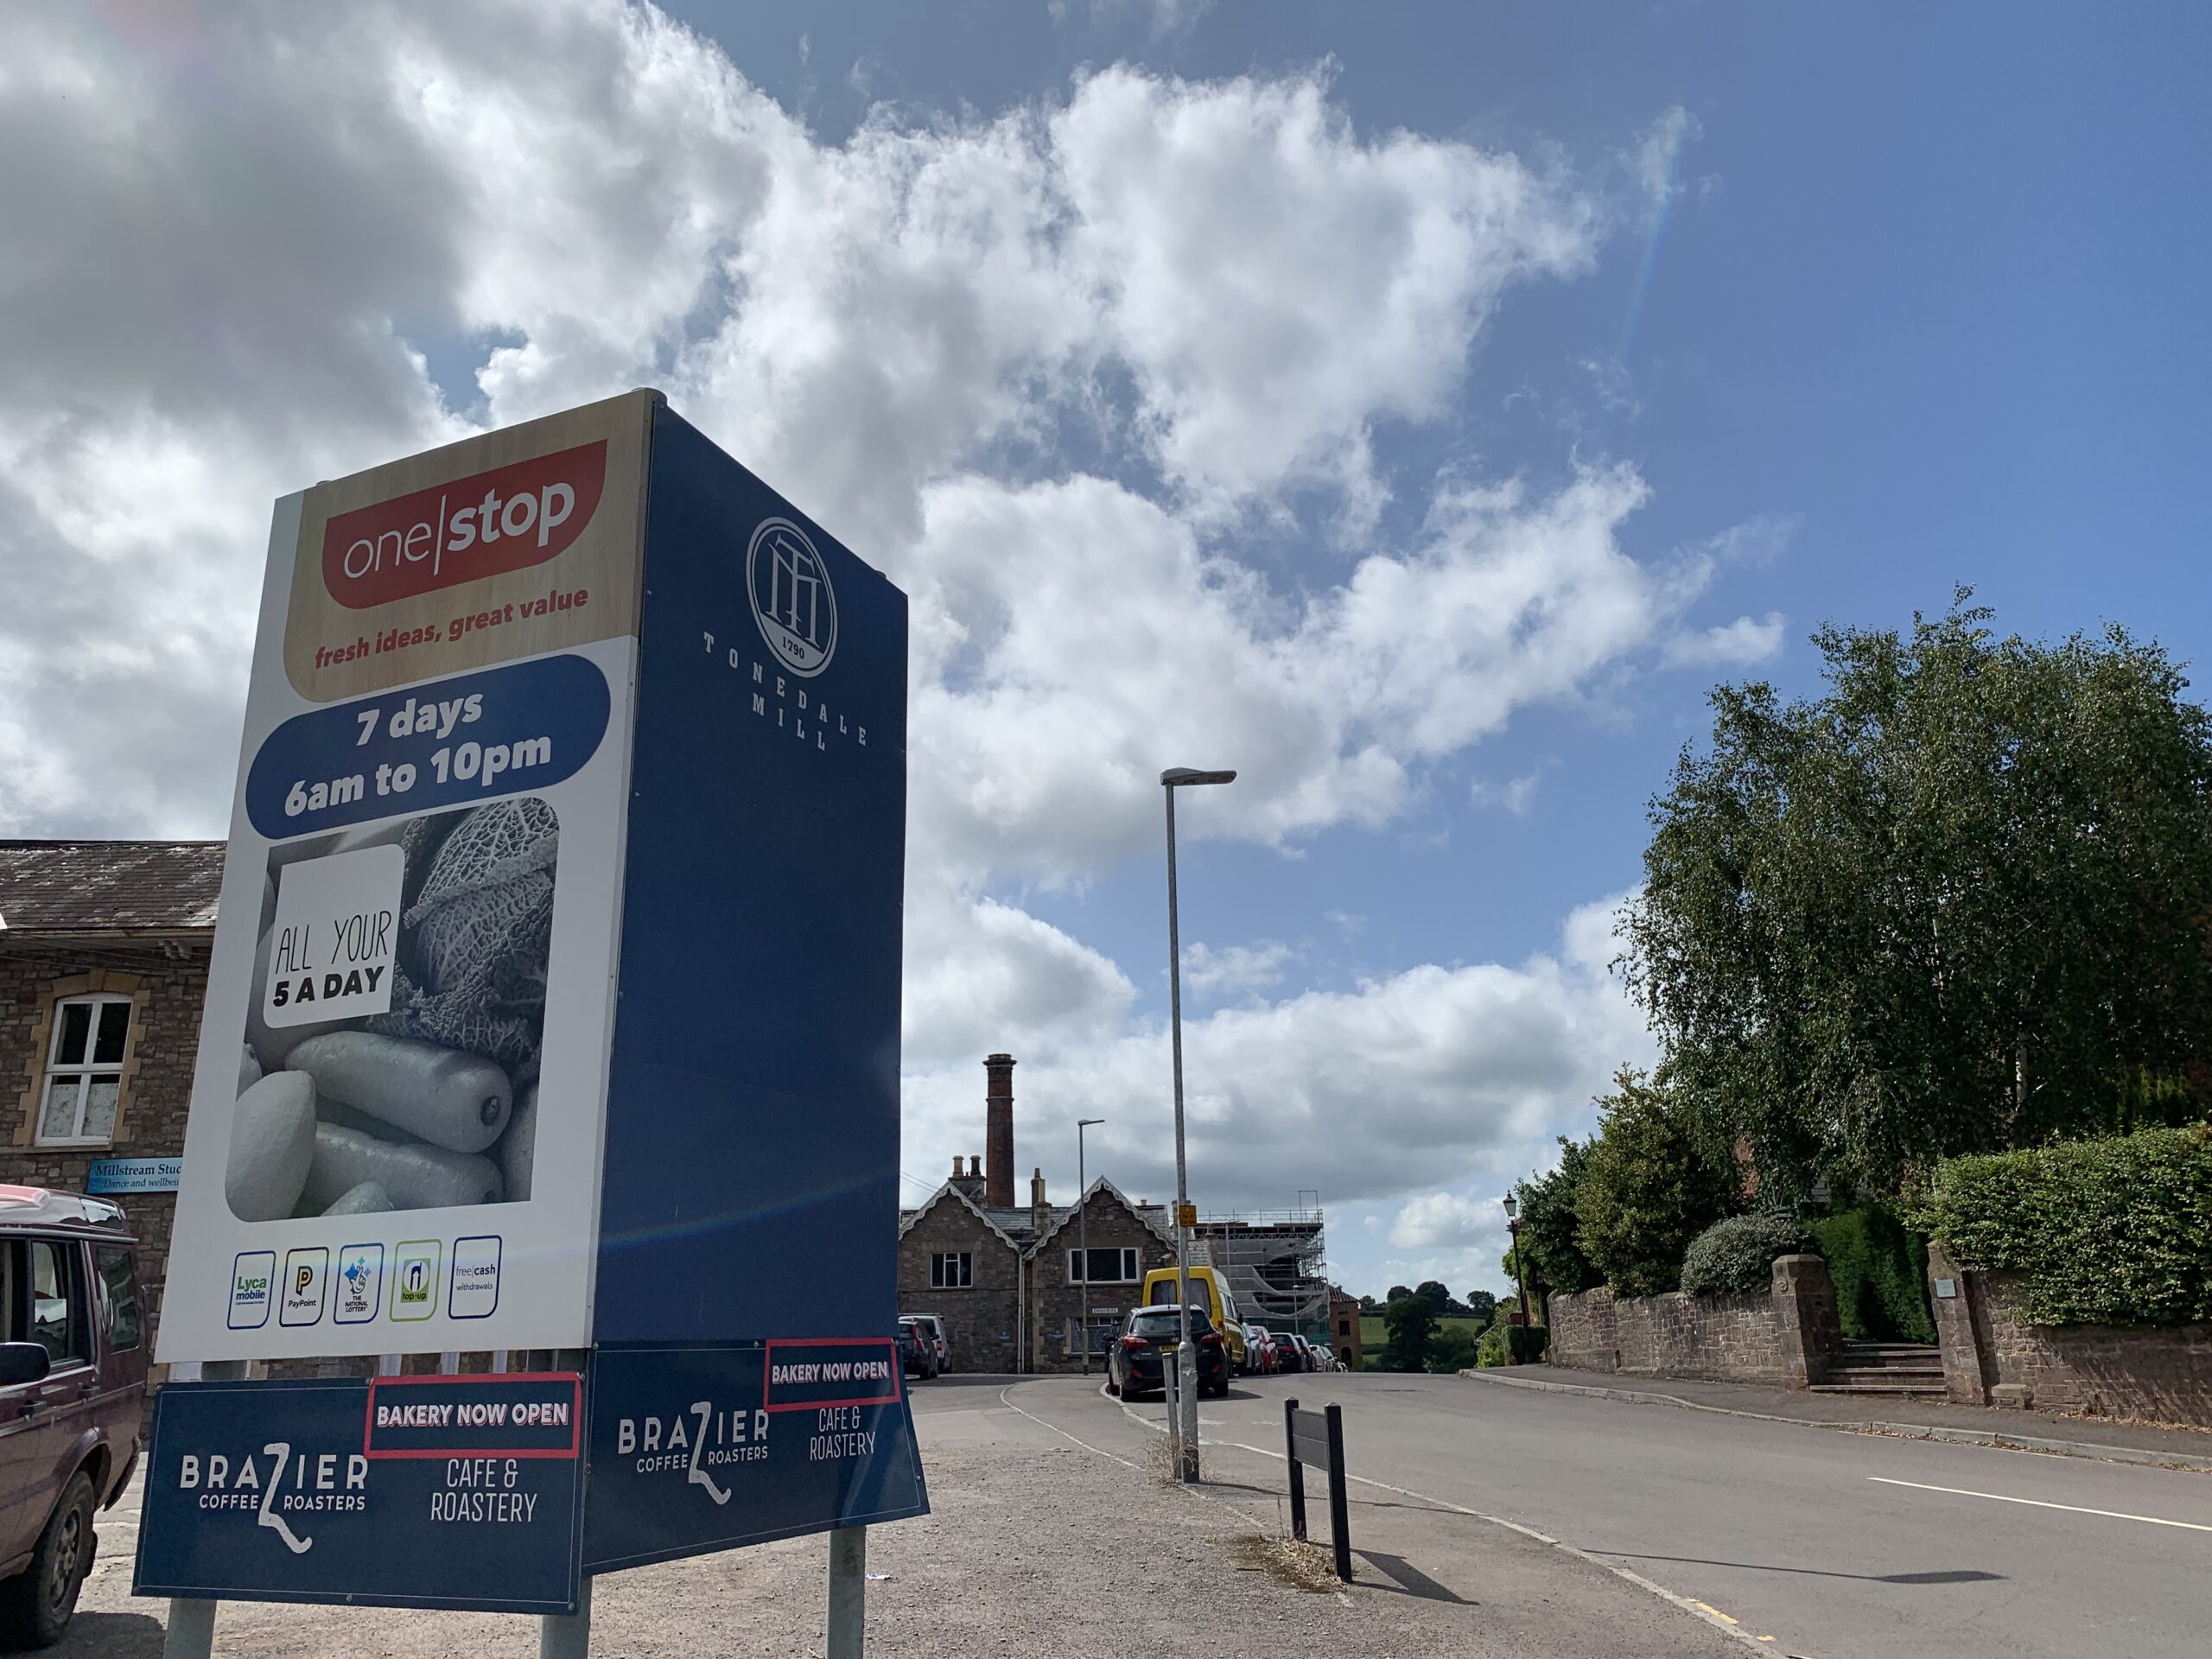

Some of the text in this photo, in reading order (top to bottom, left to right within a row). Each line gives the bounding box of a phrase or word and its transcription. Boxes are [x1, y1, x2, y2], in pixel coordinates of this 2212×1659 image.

[315, 588, 588, 669] fresh ideas, great value
[782, 636, 805, 660] 1790
[703, 631, 867, 746] TONEDALE
[355, 694, 483, 746] 7 days
[753, 693, 825, 751] MILL
[283, 736, 551, 817] 6am to 10pm
[275, 910, 391, 974] ALL YOUR
[272, 966, 385, 1007] 5 A DAY
[96, 1164, 155, 1176] Millstream
[104, 1179, 129, 1189] Dance
[130, 1179, 146, 1187] and
[236, 1290, 265, 1300] mobile
[238, 1276, 267, 1292] Lyca
[456, 1281, 493, 1291] withdrawals
[288, 1300, 317, 1308] PayPoint
[772, 1361, 890, 1384] BAKERY NOW OPEN
[377, 1402, 569, 1427] BAKERY NOW OPEN
[818, 1406, 861, 1433] CAFE &
[637, 1446, 768, 1473] COFFEE ROASTERS
[810, 1431, 876, 1461] ROASTERY
[447, 1459, 519, 1488] CAFE &
[199, 1493, 365, 1511] COFFEE ROASTERS
[431, 1492, 537, 1522] ROASTERY
